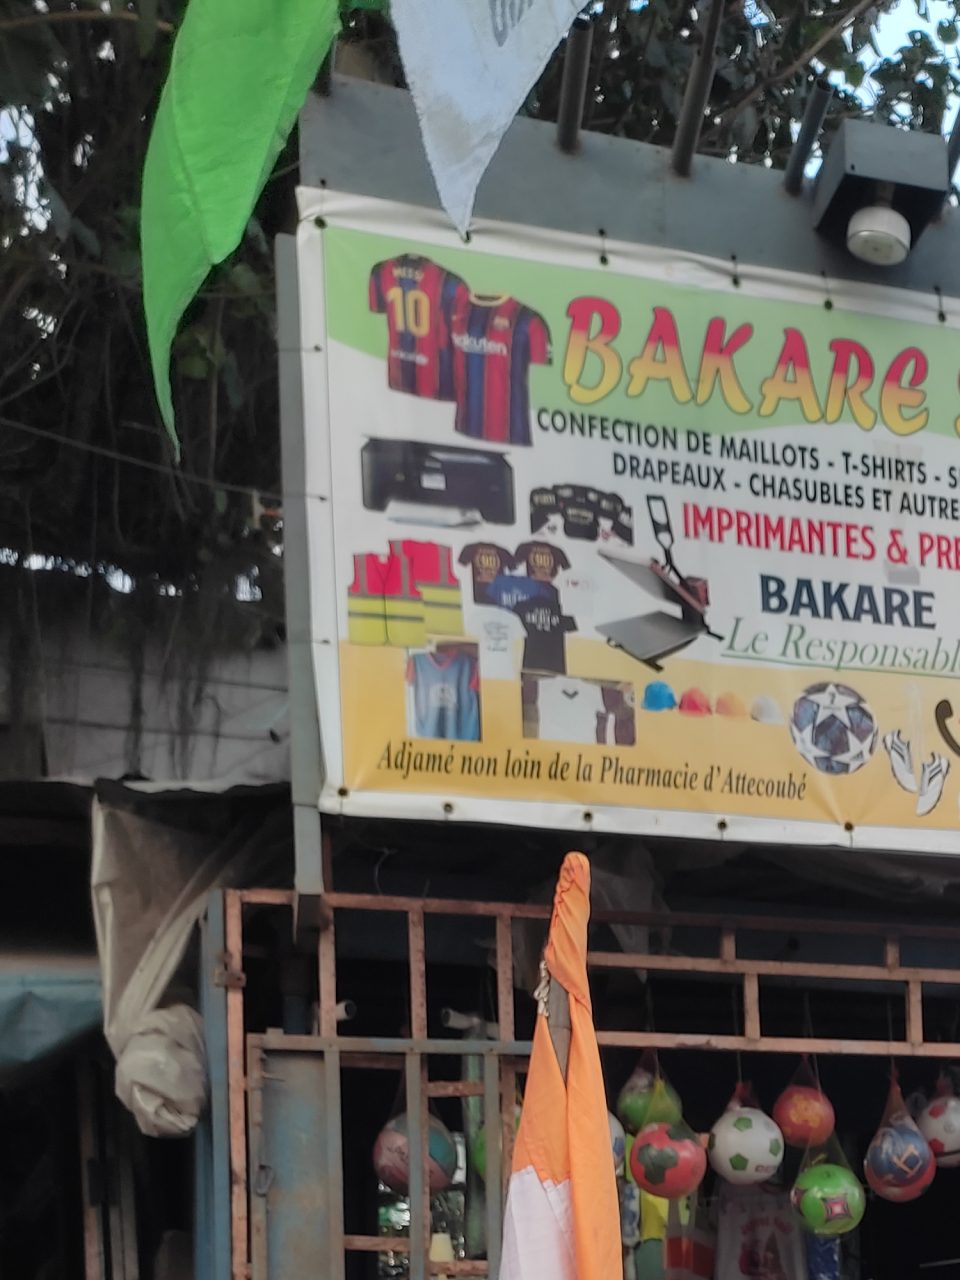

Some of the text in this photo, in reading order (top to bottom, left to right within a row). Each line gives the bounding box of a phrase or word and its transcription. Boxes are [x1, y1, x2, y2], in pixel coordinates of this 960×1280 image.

[387, 286, 430, 337] 10
[563, 296, 930, 437] BAKARE
[537, 408, 678, 450] CONFECTION
[686, 430, 712, 455] DE
[720, 433, 820, 470] MAILLOTS
[843, 451, 927, 484] T-SHIRTS
[613, 452, 726, 491] DRAPEAUX
[749, 472, 865, 509] CHASUBLES
[872, 487, 896, 512] ET
[683, 503, 877, 562] IMPRIMANTES
[886, 527, 908, 562] &
[759, 573, 936, 629] BAKARE
[724, 616, 770, 655] Le
[377, 740, 454, 782] Adjamé
[460, 754, 497, 778] non
[504, 748, 542, 780] loin
[548, 751, 571, 781] de
[575, 756, 593, 784] la
[600, 759, 698, 792] Pharmacie
